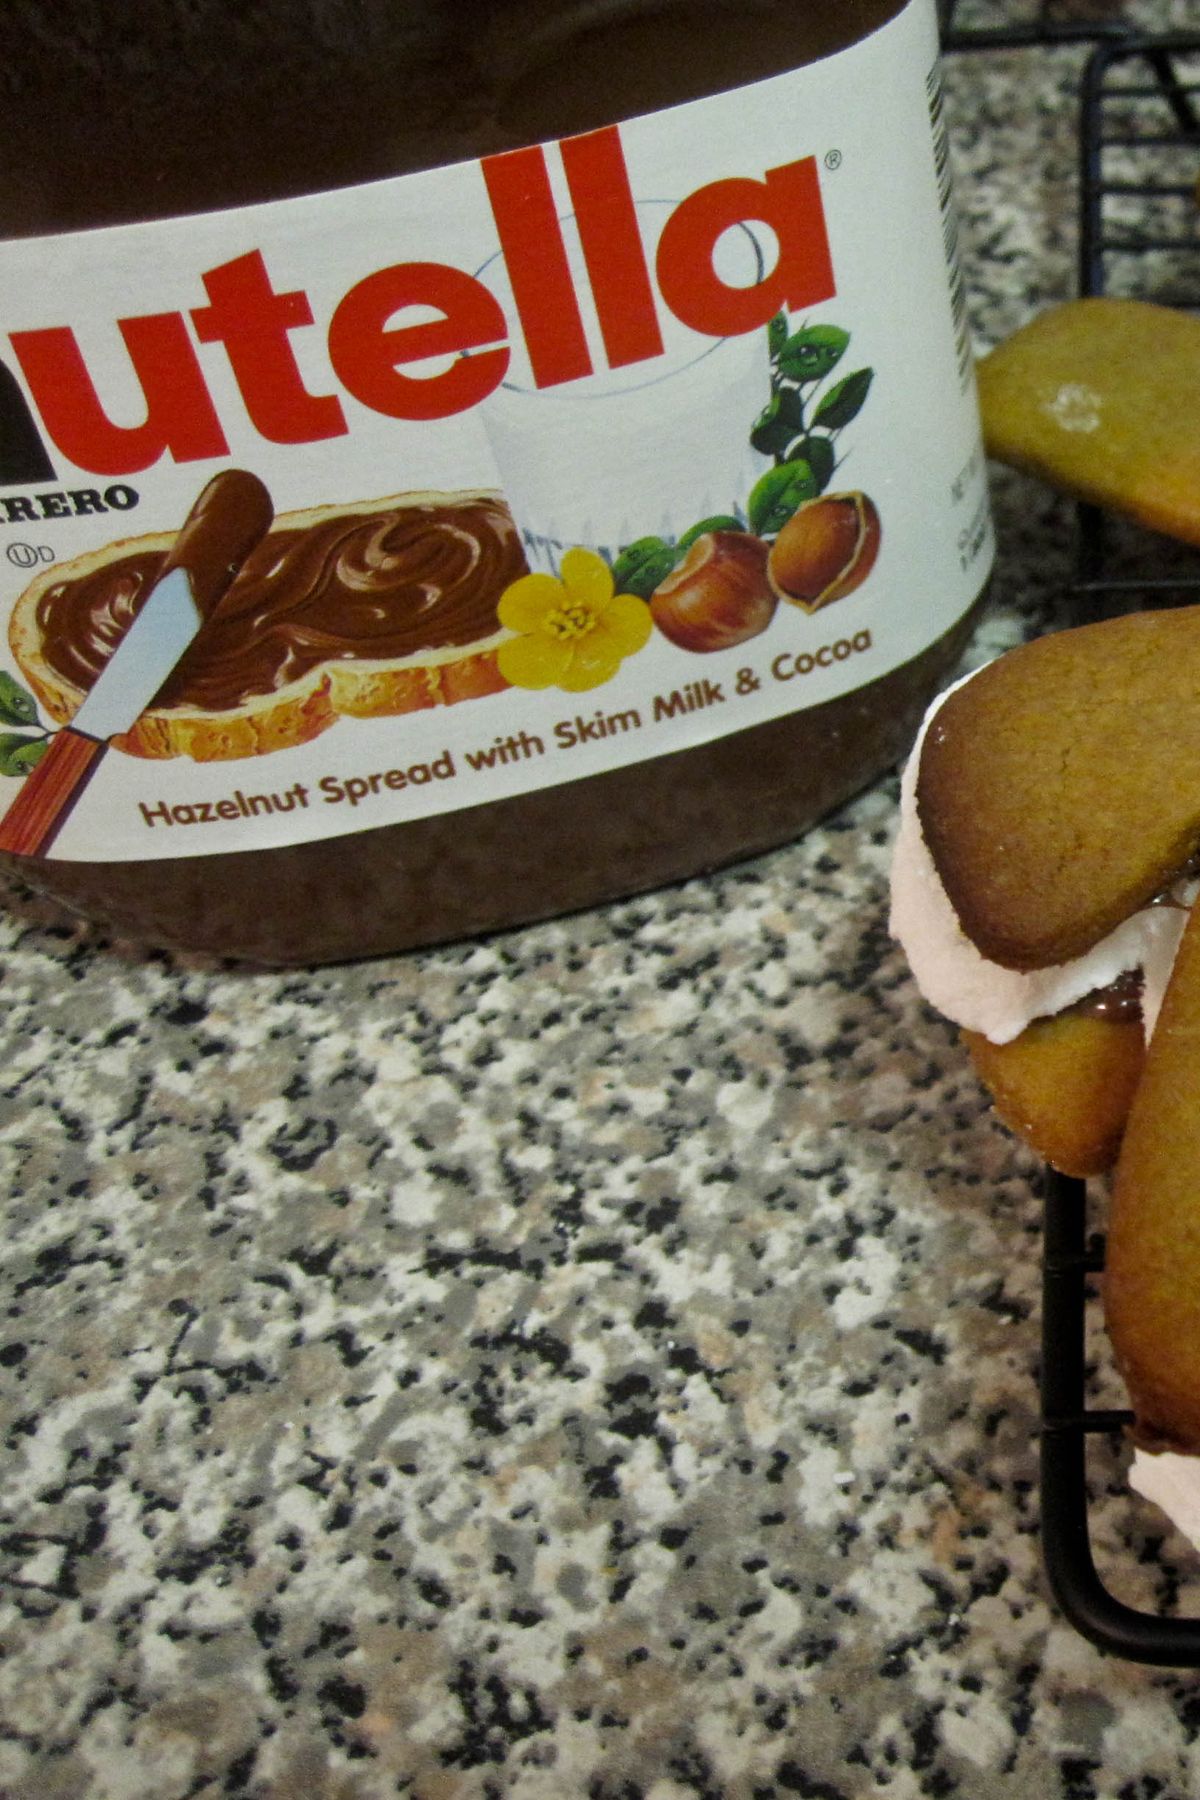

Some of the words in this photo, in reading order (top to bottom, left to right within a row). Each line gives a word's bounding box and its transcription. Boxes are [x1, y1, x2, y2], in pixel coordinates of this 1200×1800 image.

[0, 484, 140, 524] RERO
[138, 784, 308, 827] Hazelnut
[318, 750, 456, 806] Spread
[465, 731, 545, 771] with
[553, 707, 643, 749] Skim
[652, 679, 726, 723] Milk
[735, 668, 761, 696] &
[771, 628, 873, 682] Cocoa
